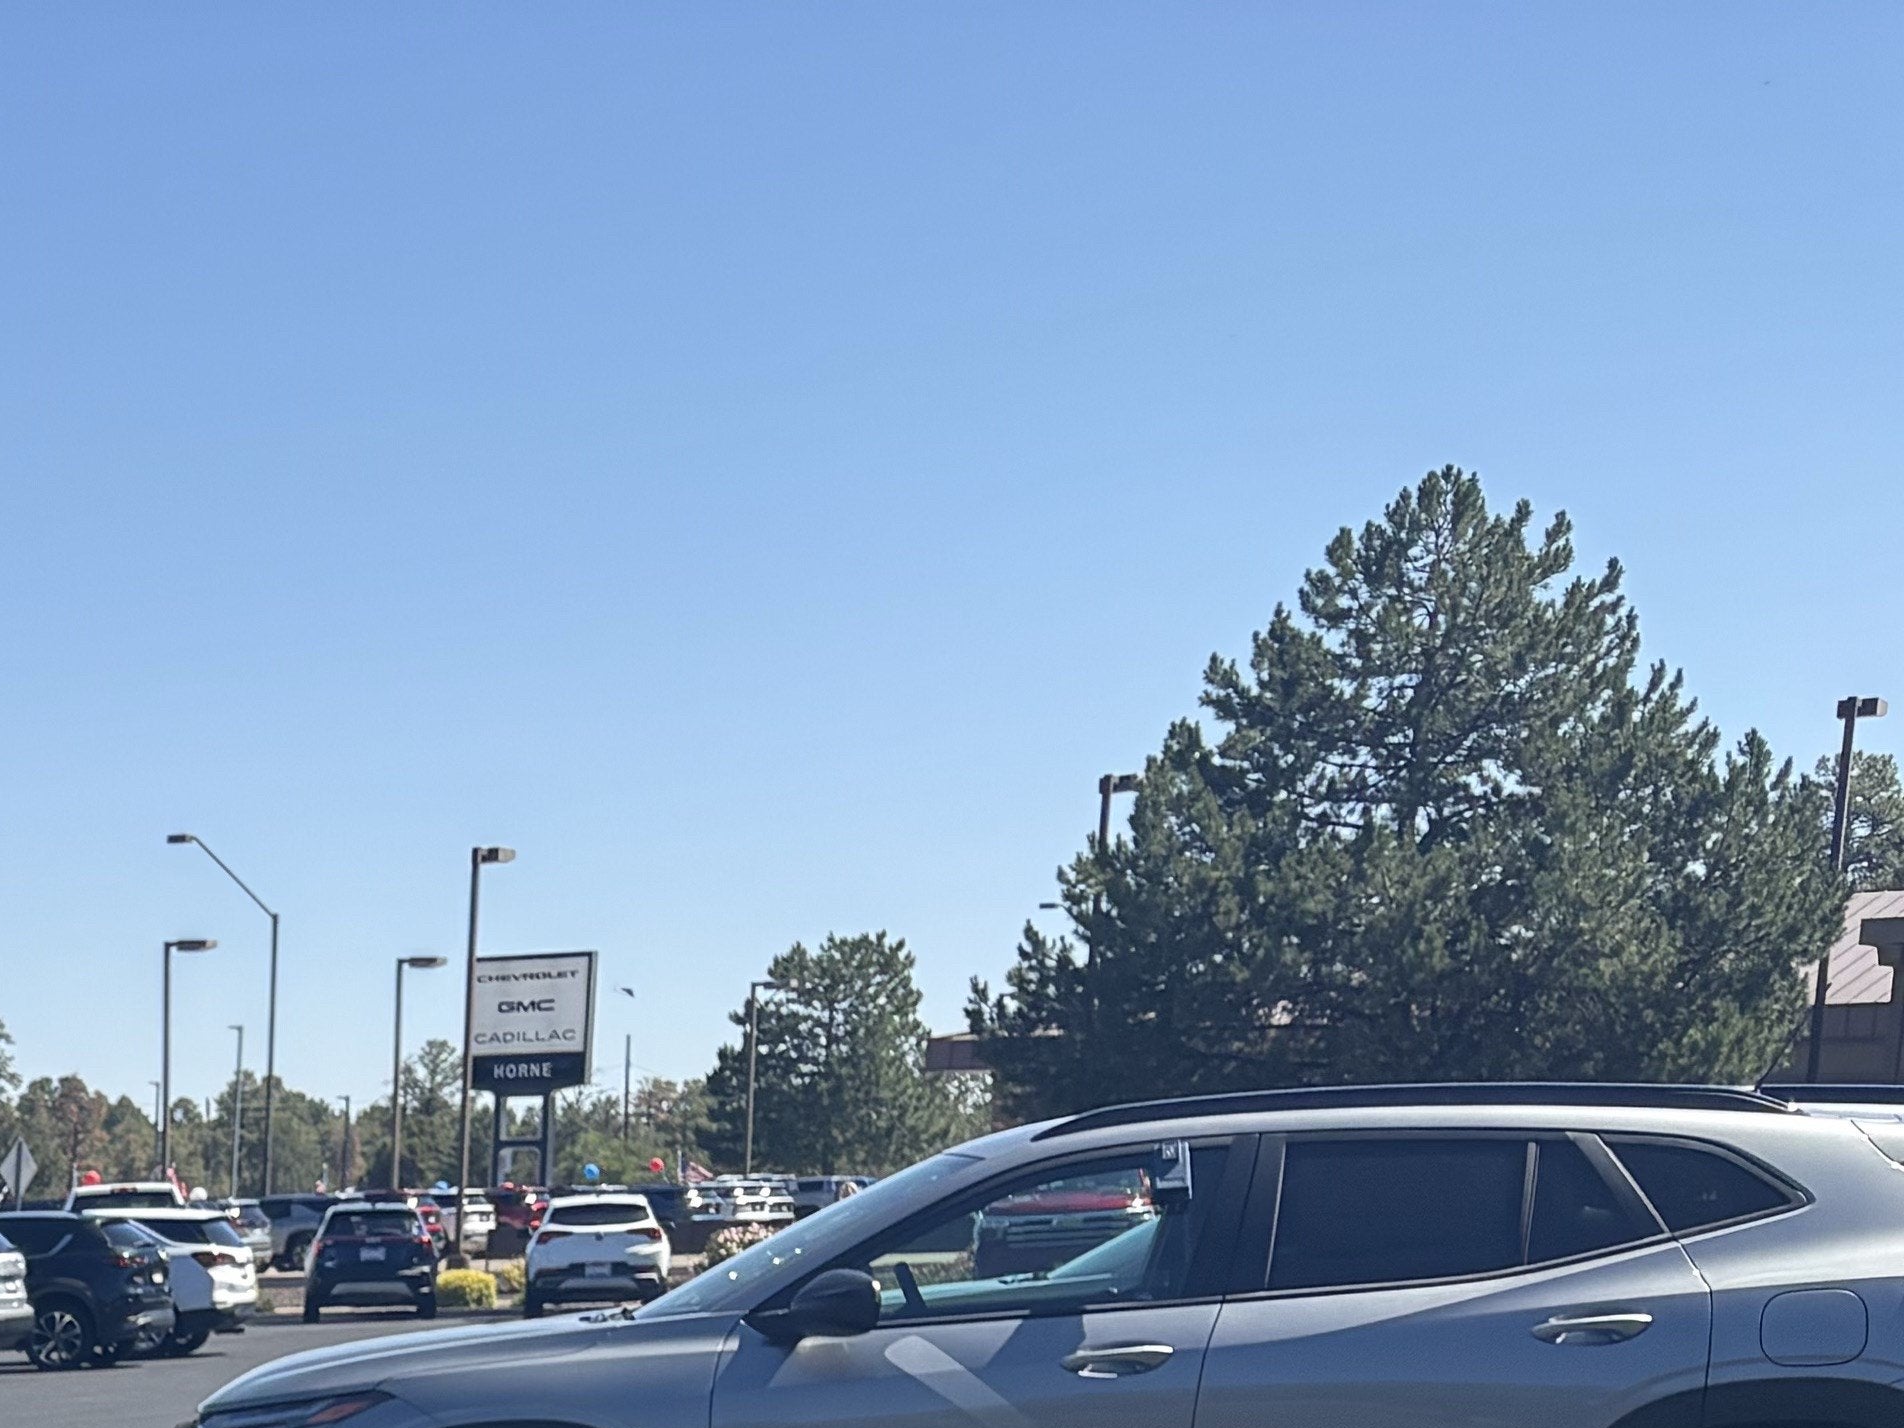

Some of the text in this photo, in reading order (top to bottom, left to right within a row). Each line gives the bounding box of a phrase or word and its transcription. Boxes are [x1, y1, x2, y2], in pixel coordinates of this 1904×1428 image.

[476, 970, 578, 983] CHEVROLET
[497, 998, 555, 1013] GMC
[474, 1029, 577, 1044] CADILLAC
[493, 1062, 553, 1079] HORNE
